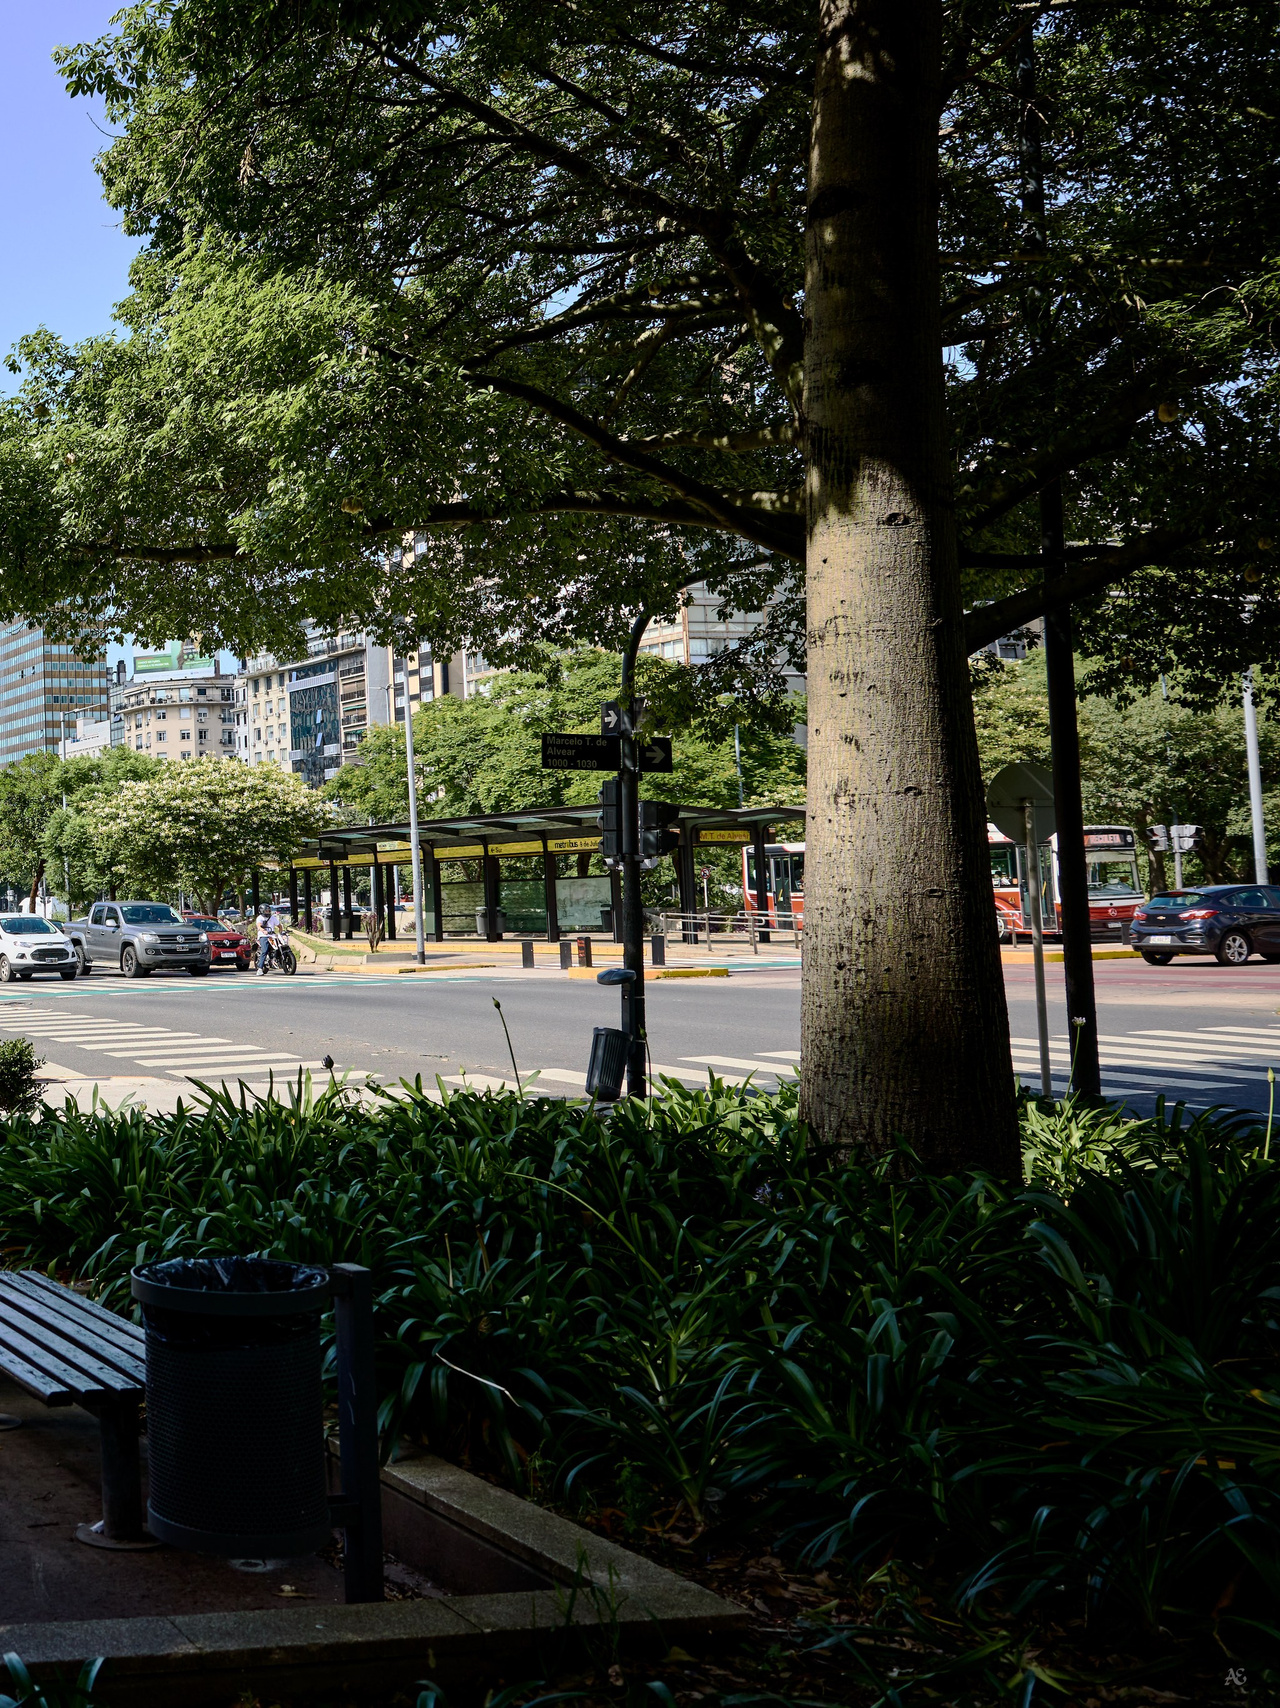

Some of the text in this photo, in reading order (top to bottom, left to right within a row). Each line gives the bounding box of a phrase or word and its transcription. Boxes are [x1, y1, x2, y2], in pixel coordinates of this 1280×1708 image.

[546, 736, 608, 746] Marcelo T. de
[546, 747, 576, 756] Alvear
[548, 759, 568, 767] 1000
[577, 760, 598, 768] 1030
[717, 832, 726, 840] de
